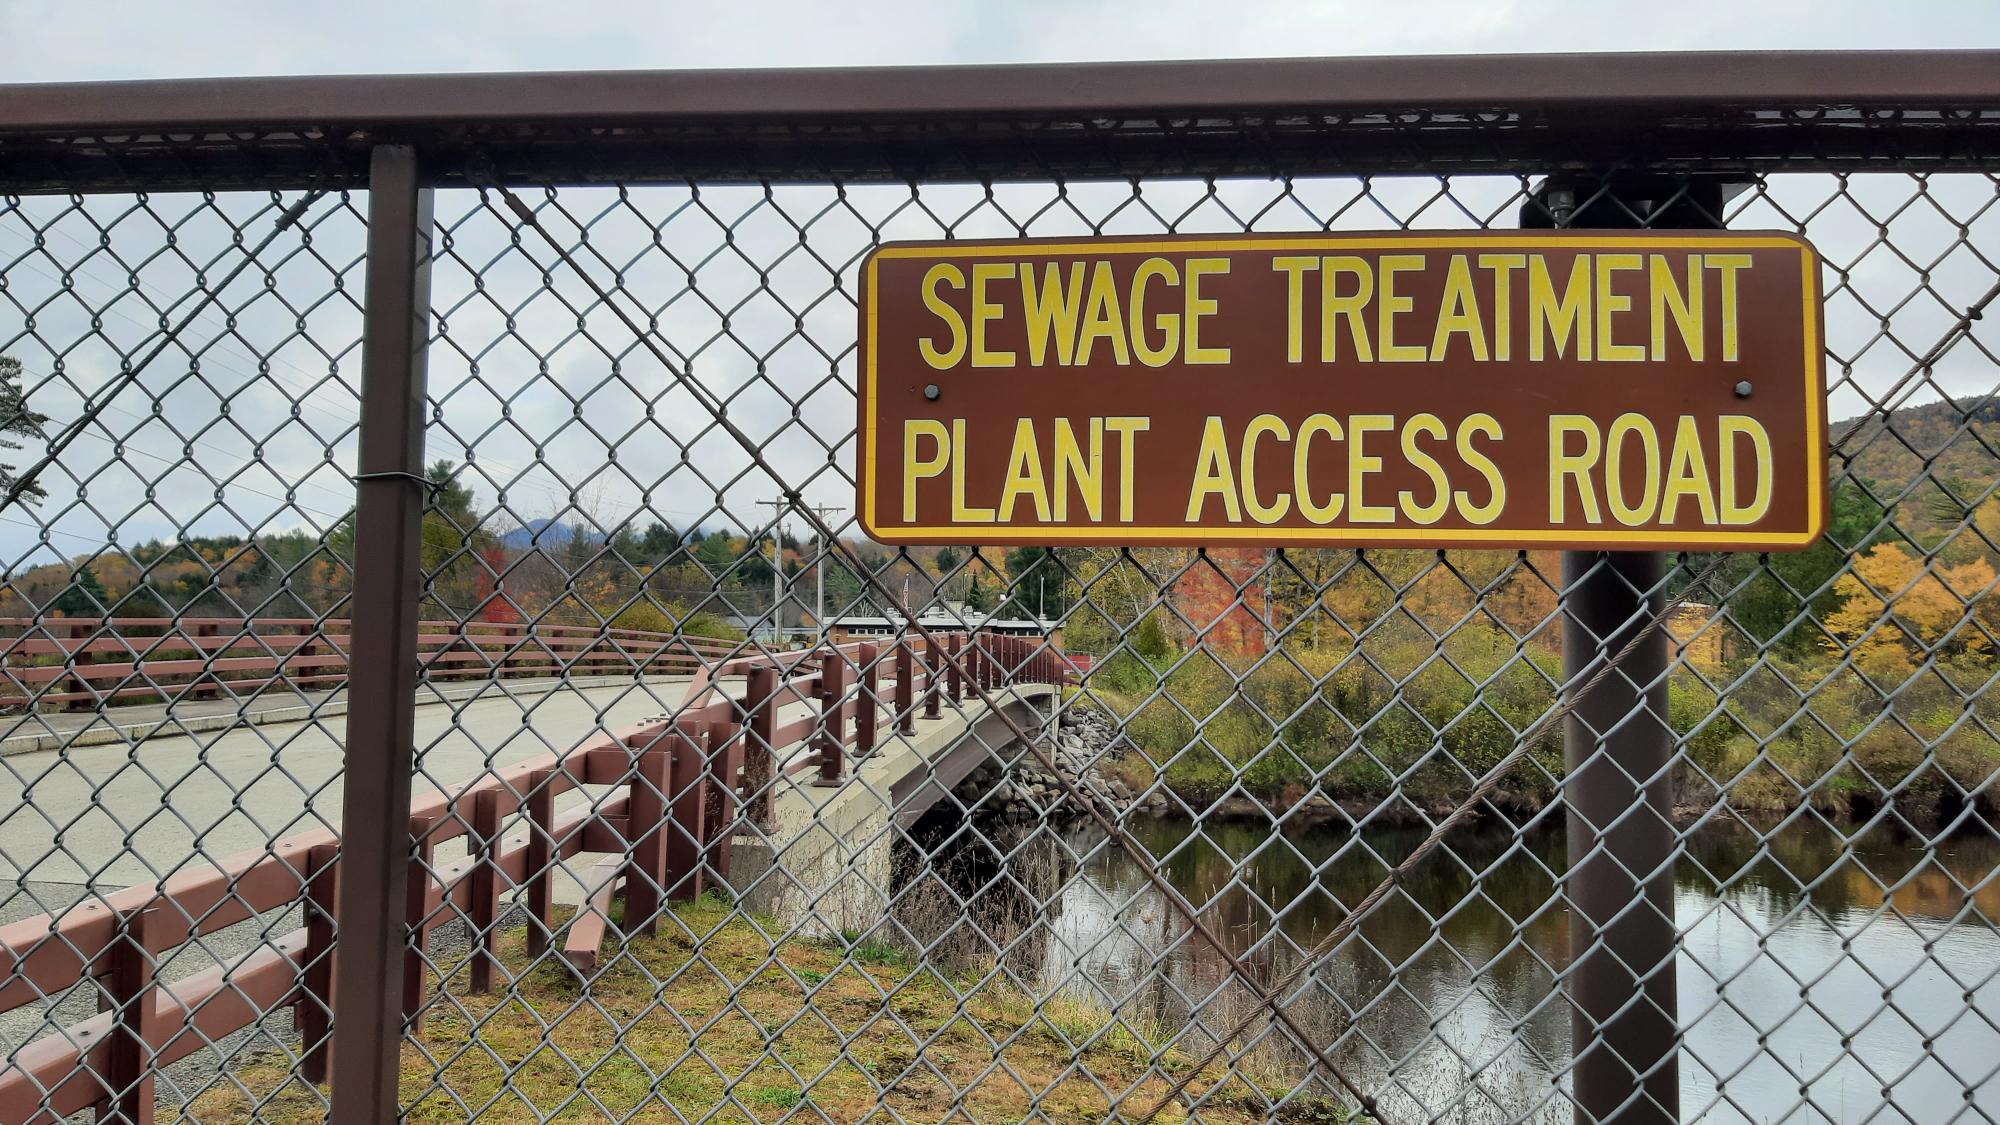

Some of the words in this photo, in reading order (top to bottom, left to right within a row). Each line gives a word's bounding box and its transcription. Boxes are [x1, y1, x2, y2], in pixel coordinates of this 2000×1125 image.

[919, 257, 1232, 369] SEWAGE
[1272, 253, 1755, 363] TREATMENT
[902, 415, 1151, 523] PLANT
[1185, 412, 1507, 526] ACCESS
[1548, 412, 1774, 527] ROAD
